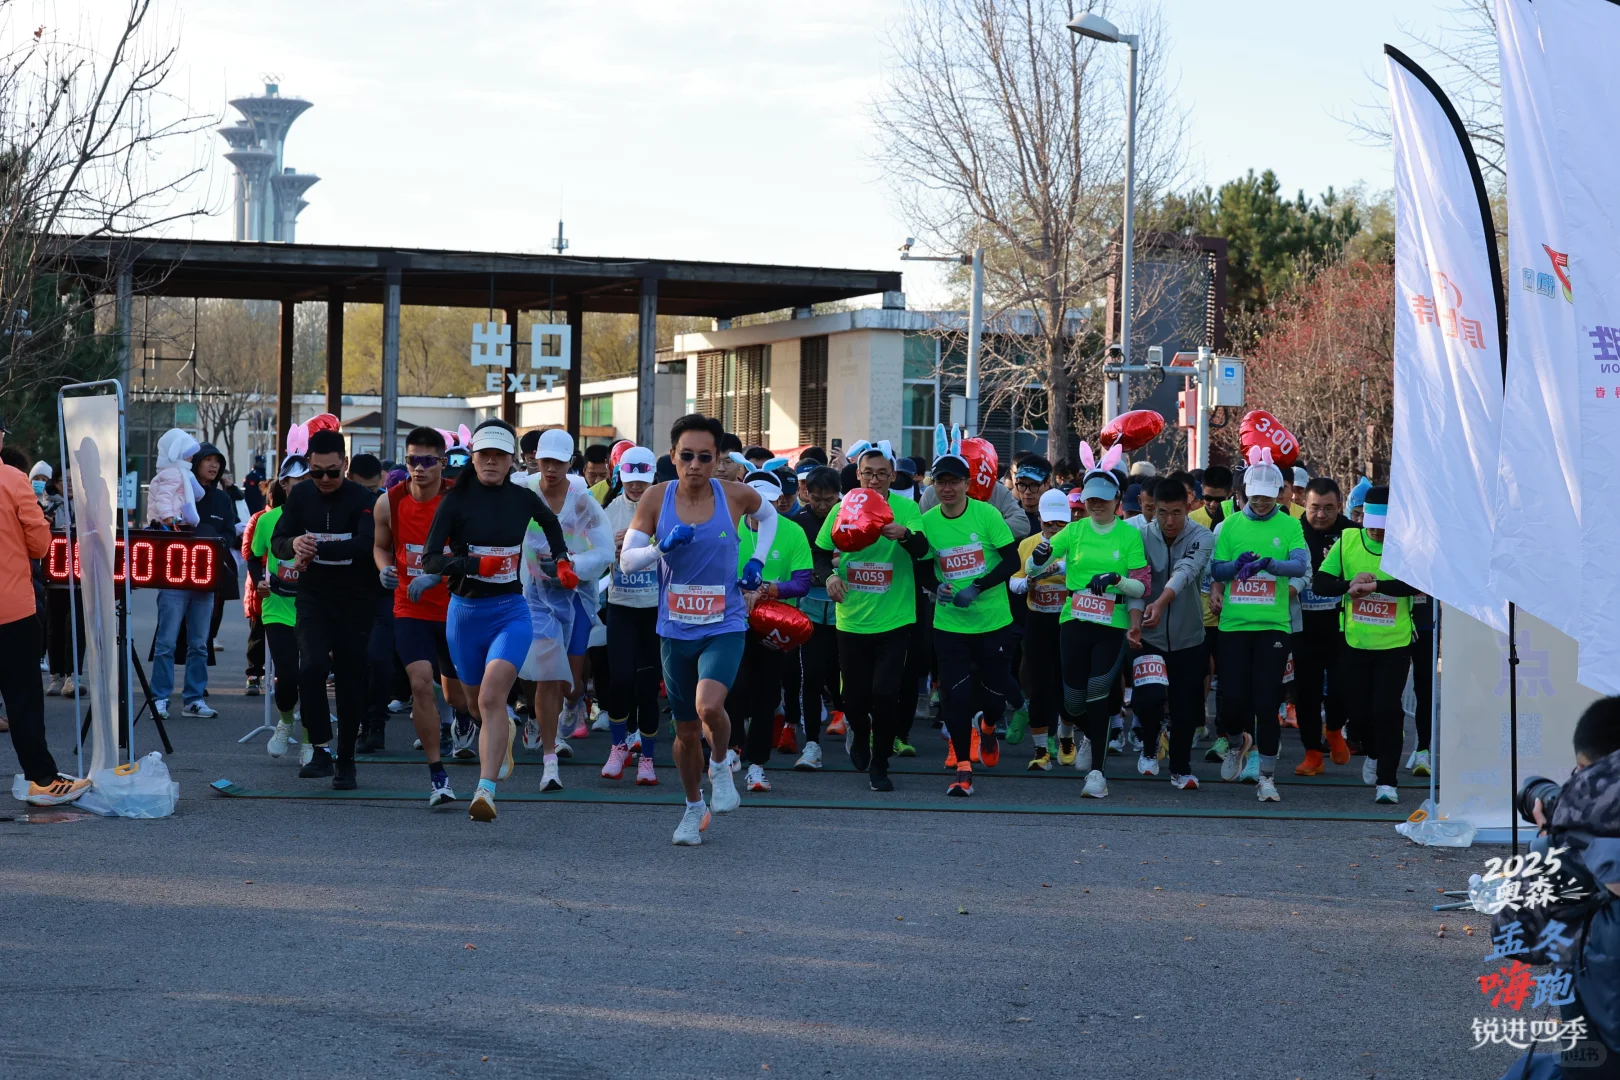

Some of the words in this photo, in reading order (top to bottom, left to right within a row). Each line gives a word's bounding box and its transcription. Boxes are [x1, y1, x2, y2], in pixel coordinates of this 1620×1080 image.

[471, 322, 571, 370] 出口
[486, 373, 558, 393] EXIT
[1255, 417, 1293, 455] 3:00
[840, 492, 868, 533] 1:45
[946, 553, 976, 569] A055
[621, 572, 652, 585] B041
[855, 570, 885, 583] A059
[1236, 581, 1268, 593] A054
[676, 596, 715, 611] A107
[1076, 596, 1107, 612] A056
[1358, 601, 1389, 615] A062
[1134, 663, 1163, 677] A100
